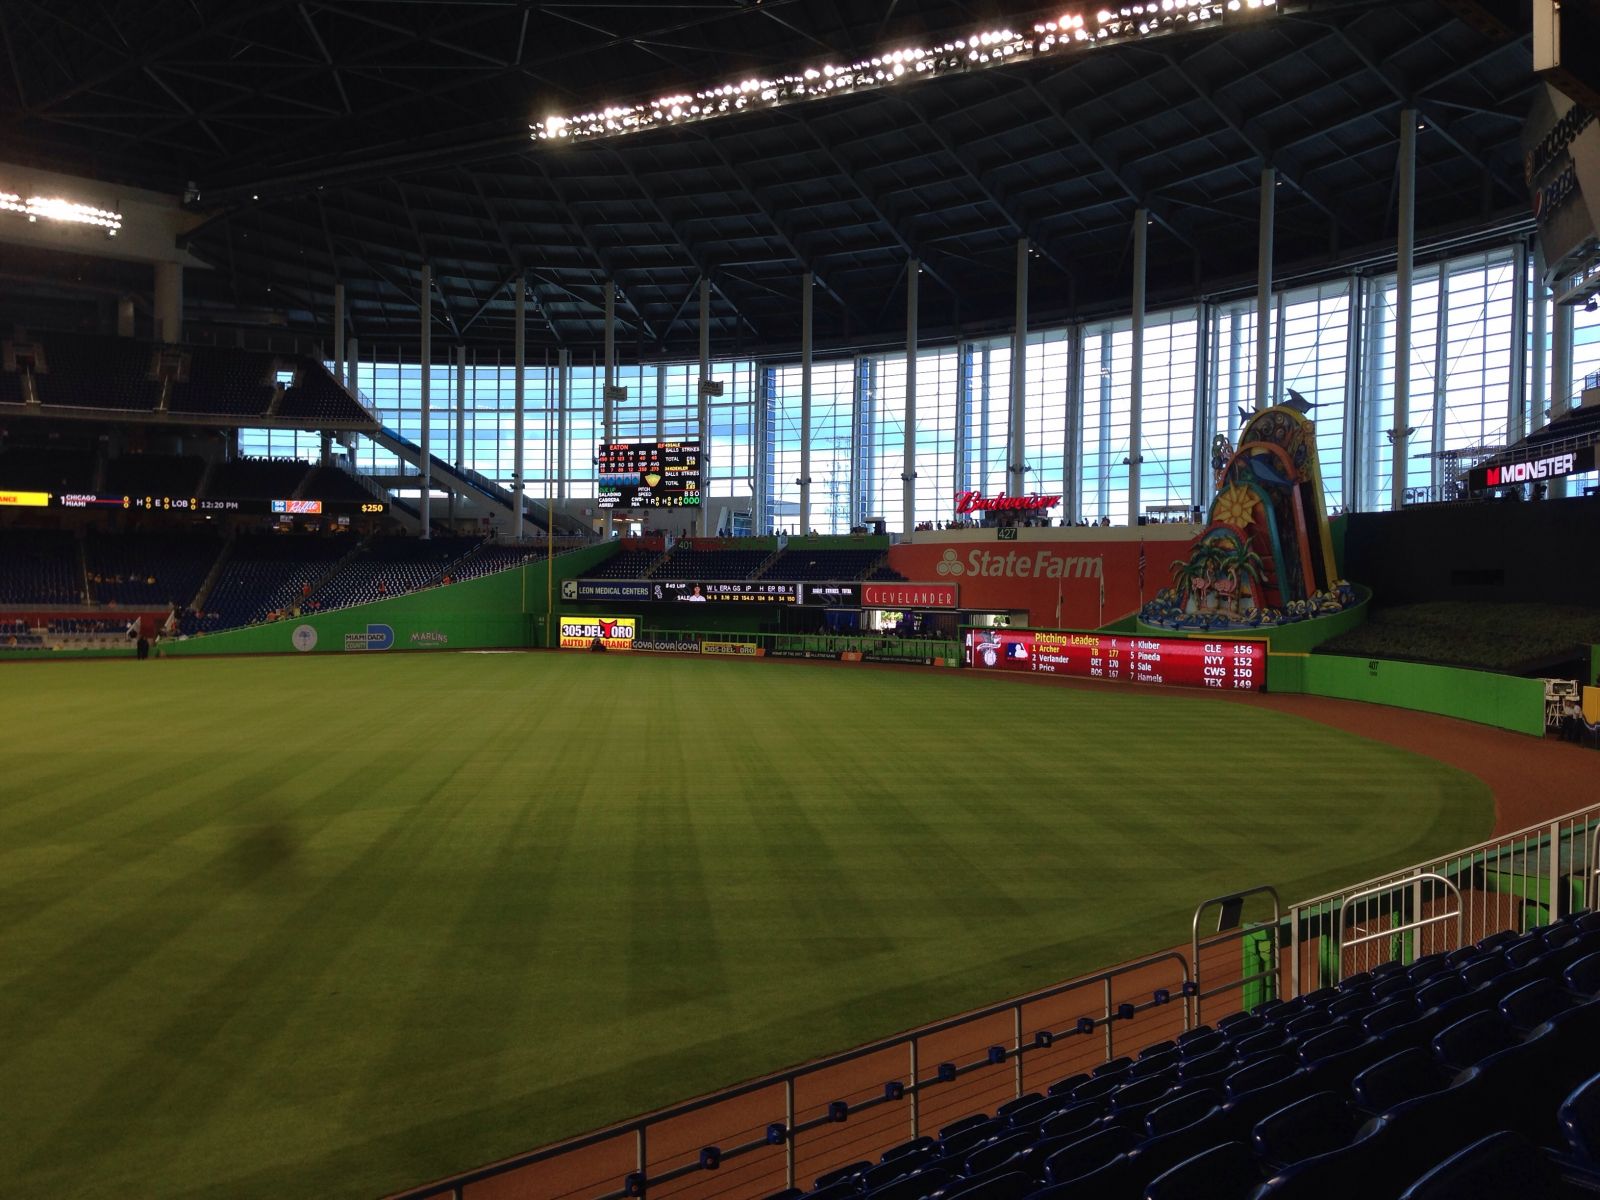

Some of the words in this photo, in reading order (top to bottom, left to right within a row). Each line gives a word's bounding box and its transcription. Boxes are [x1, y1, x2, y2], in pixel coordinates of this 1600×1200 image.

[1501, 453, 1573, 484] MONSTER
[60, 496, 65, 505] 1
[66, 494, 96, 502] CHICAGO
[136, 498, 143, 506] H
[155, 499, 161, 507] E
[171, 499, 188, 507] LOB
[201, 501, 224, 509] 12:20
[954, 490, 1062, 514] Budweiser
[288, 500, 318, 513] Raffle
[361, 504, 383, 513] $250
[998, 528, 1016, 539] 427
[678, 541, 693, 550] 401
[966, 549, 1031, 577] State
[1033, 550, 1103, 578] Farm
[579, 586, 594, 595] LEON
[595, 586, 620, 595] MEDICAL
[622, 587, 649, 596] CENTERS
[720, 584, 732, 592] ERA
[865, 587, 952, 605] CLEVELANDER
[345, 633, 367, 641] MIAMI
[410, 631, 448, 643] MARLINS
[1035, 632, 1067, 646] Pitching
[1071, 634, 1099, 646] Leaders
[1111, 638, 1117, 647] K
[561, 639, 584, 647] AUTO
[632, 640, 653, 650] GOYA
[654, 641, 676, 651] GOYA
[677, 642, 699, 652] GOYA
[1137, 640, 1160, 650] Kluber
[1204, 644, 1221, 653] CLE
[1233, 645, 1253, 655] 156
[1039, 645, 1060, 653] Archer
[1091, 648, 1099, 656] TB
[1108, 649, 1119, 657] 177
[1032, 653, 1036, 661] 2
[1039, 654, 1069, 664] Verlander
[1090, 658, 1102, 666] DET
[1108, 659, 1119, 668] 170
[1130, 651, 1134, 659] 5
[1137, 652, 1160, 661] Pineda
[1204, 656, 1224, 665] NYY
[1233, 657, 1253, 667] 152
[1032, 663, 1036, 671] 3
[1039, 663, 1055, 672] Price
[1090, 668, 1102, 676] BOS
[1108, 670, 1118, 678] 167
[1130, 662, 1134, 670] 6
[1137, 662, 1152, 672] Sale
[1204, 667, 1226, 676] CWS
[1233, 668, 1253, 678] 150
[1130, 672, 1134, 680] 7
[1137, 672, 1162, 683] Hamels
[1204, 678, 1222, 687] TEX
[1233, 679, 1252, 689] 149
